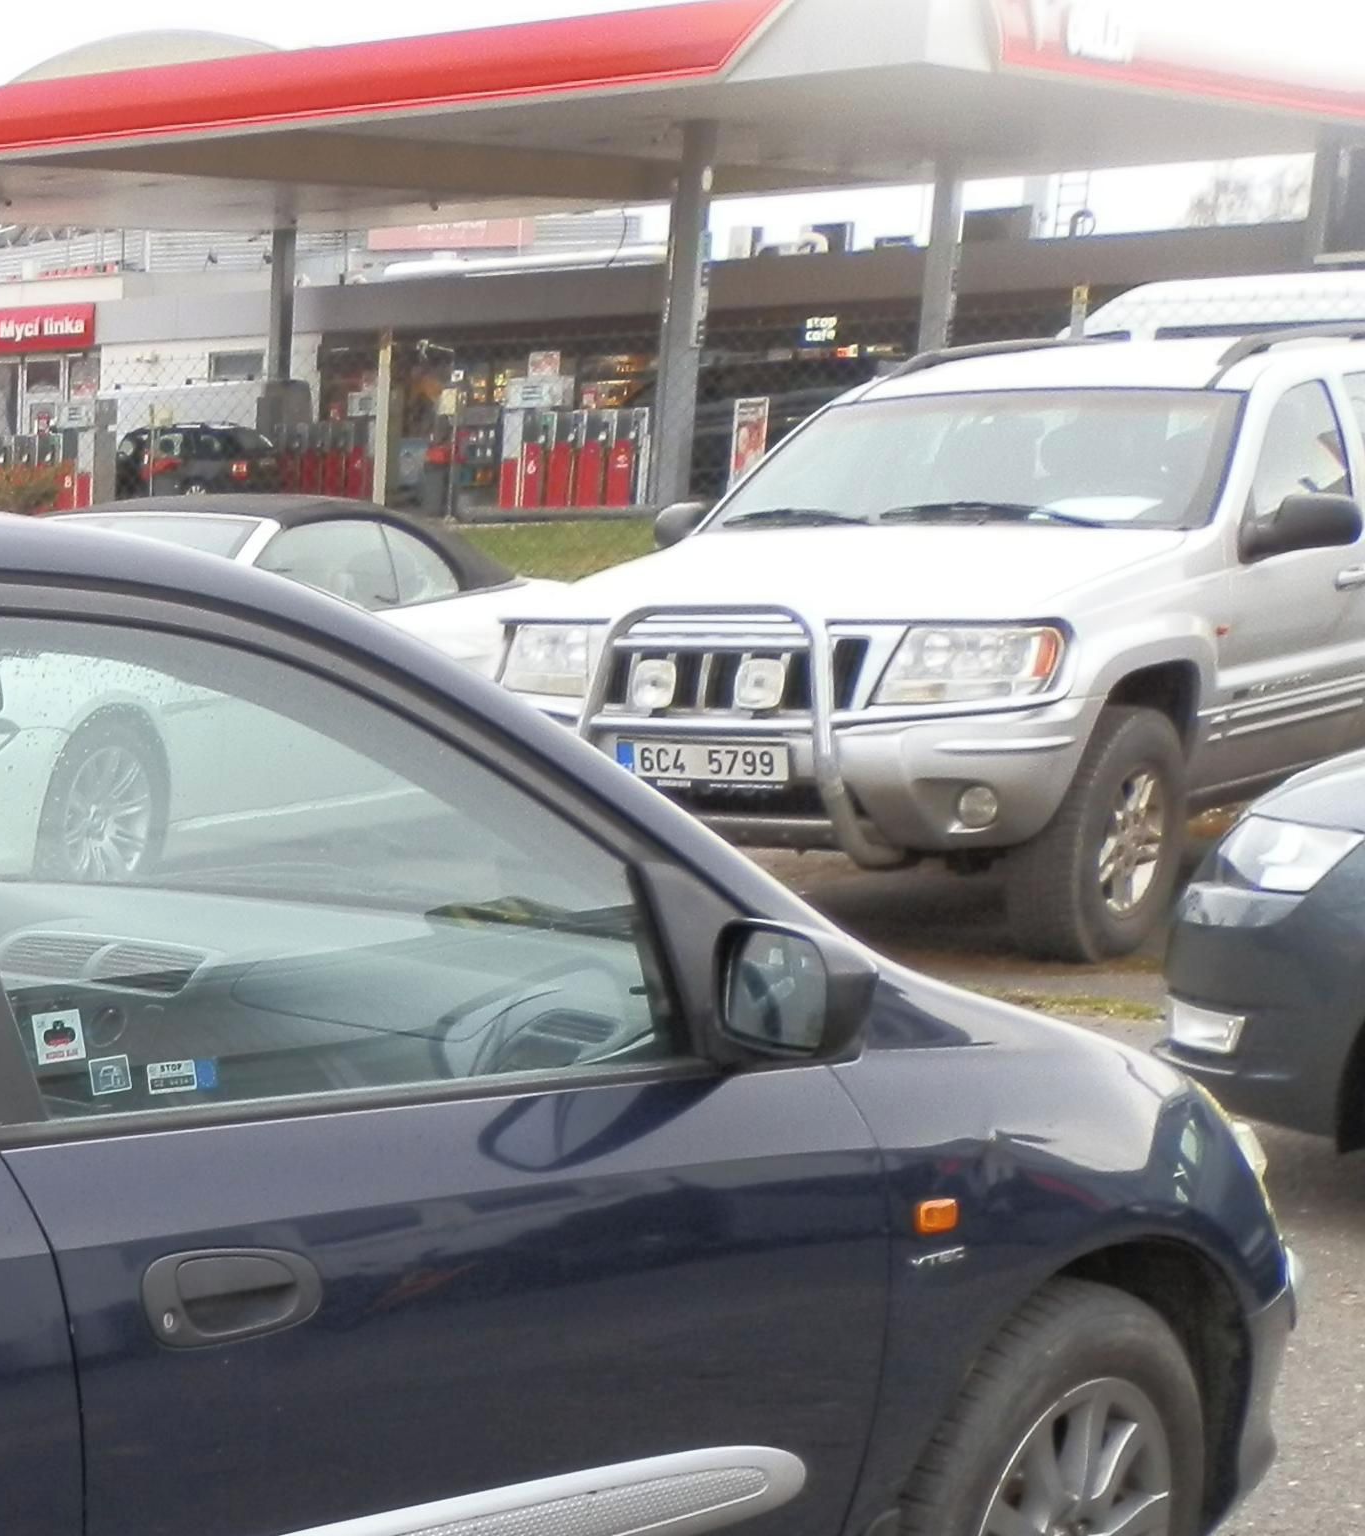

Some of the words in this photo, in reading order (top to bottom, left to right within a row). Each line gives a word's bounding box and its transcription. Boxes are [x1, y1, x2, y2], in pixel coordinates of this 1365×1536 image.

[0, 315, 40, 342] Mycí
[43, 316, 85, 336] linka
[806, 316, 838, 329] stop
[526, 459, 536, 474] 6
[640, 747, 686, 774] 6C4
[708, 749, 774, 776] 5799
